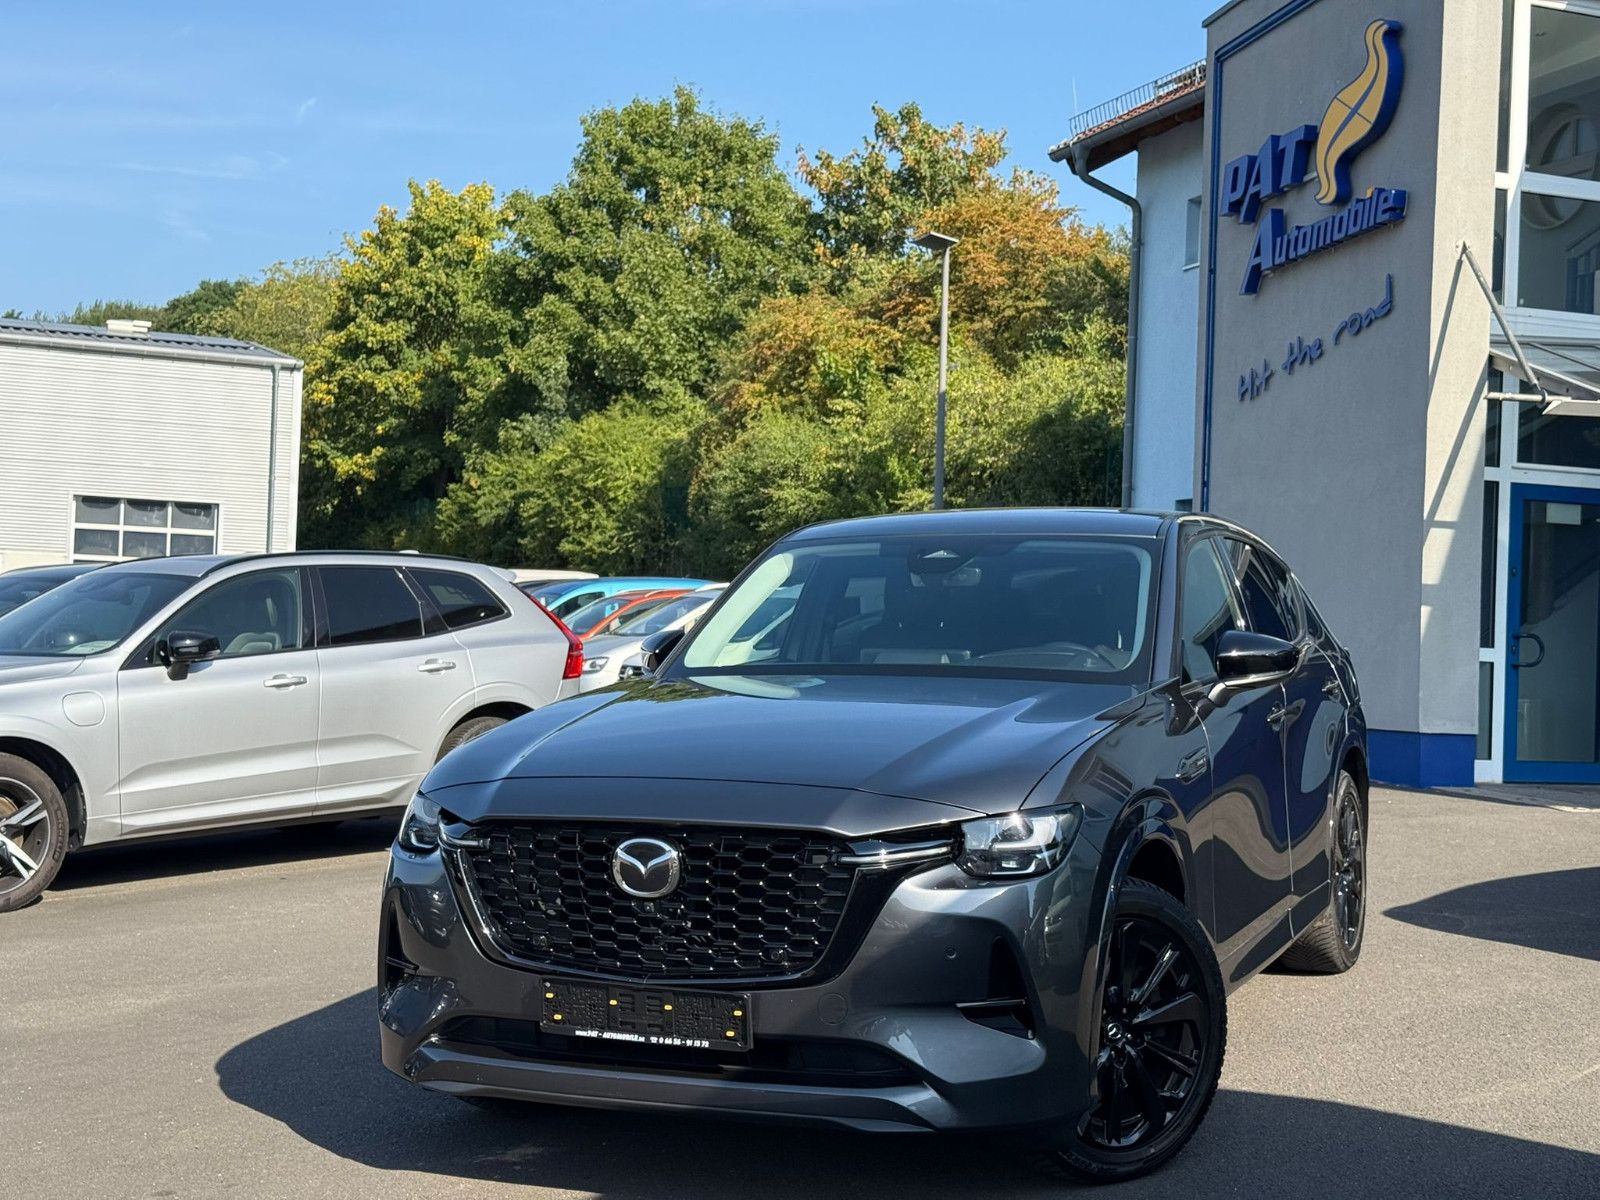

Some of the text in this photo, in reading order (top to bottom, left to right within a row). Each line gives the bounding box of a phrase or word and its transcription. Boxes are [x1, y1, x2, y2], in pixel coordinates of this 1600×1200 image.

[1219, 124, 1318, 224] PAT
[1239, 186, 1407, 295] Automobile
[1237, 273, 1393, 401] Hit the road
